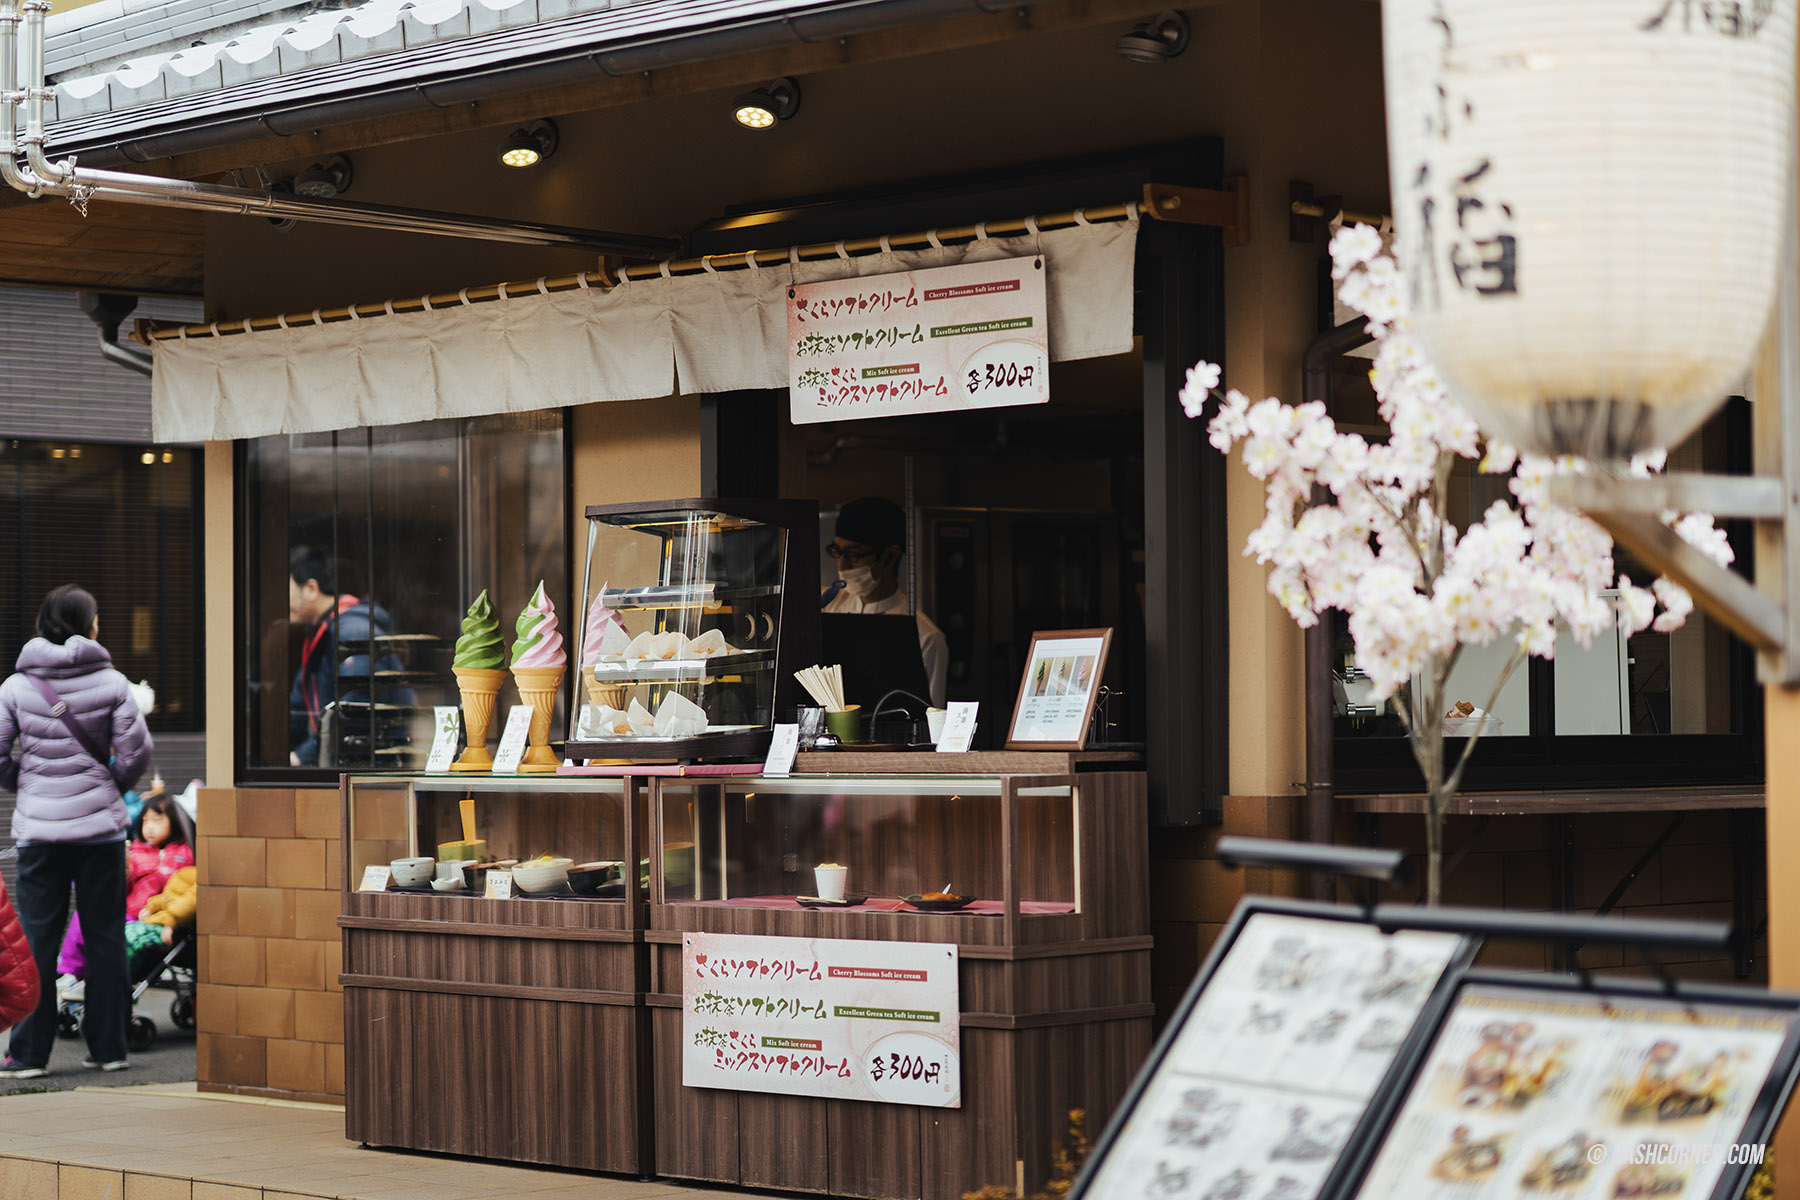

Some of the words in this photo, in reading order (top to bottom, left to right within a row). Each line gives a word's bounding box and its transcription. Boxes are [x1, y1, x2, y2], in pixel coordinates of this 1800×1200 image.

[928, 291, 948, 299] Cherry
[949, 288, 974, 296] Blossoms
[975, 285, 987, 293] Soft
[987, 284, 996, 292] ice
[935, 327, 961, 336] Excellent
[961, 325, 978, 333] Green
[988, 322, 1000, 330] Soft
[1001, 321, 1010, 329] ice
[833, 968, 853, 978] Cherry
[853, 969, 880, 977] Blossoms
[881, 970, 893, 978] Soft
[894, 971, 903, 979] ice
[838, 1008, 866, 1016] Excellent
[866, 1009, 883, 1017] Green
[894, 1011, 907, 1019] Soft
[766, 1038, 777, 1046] Mix
[778, 1039, 790, 1047] Soft
[790, 1040, 799, 1048] ice
